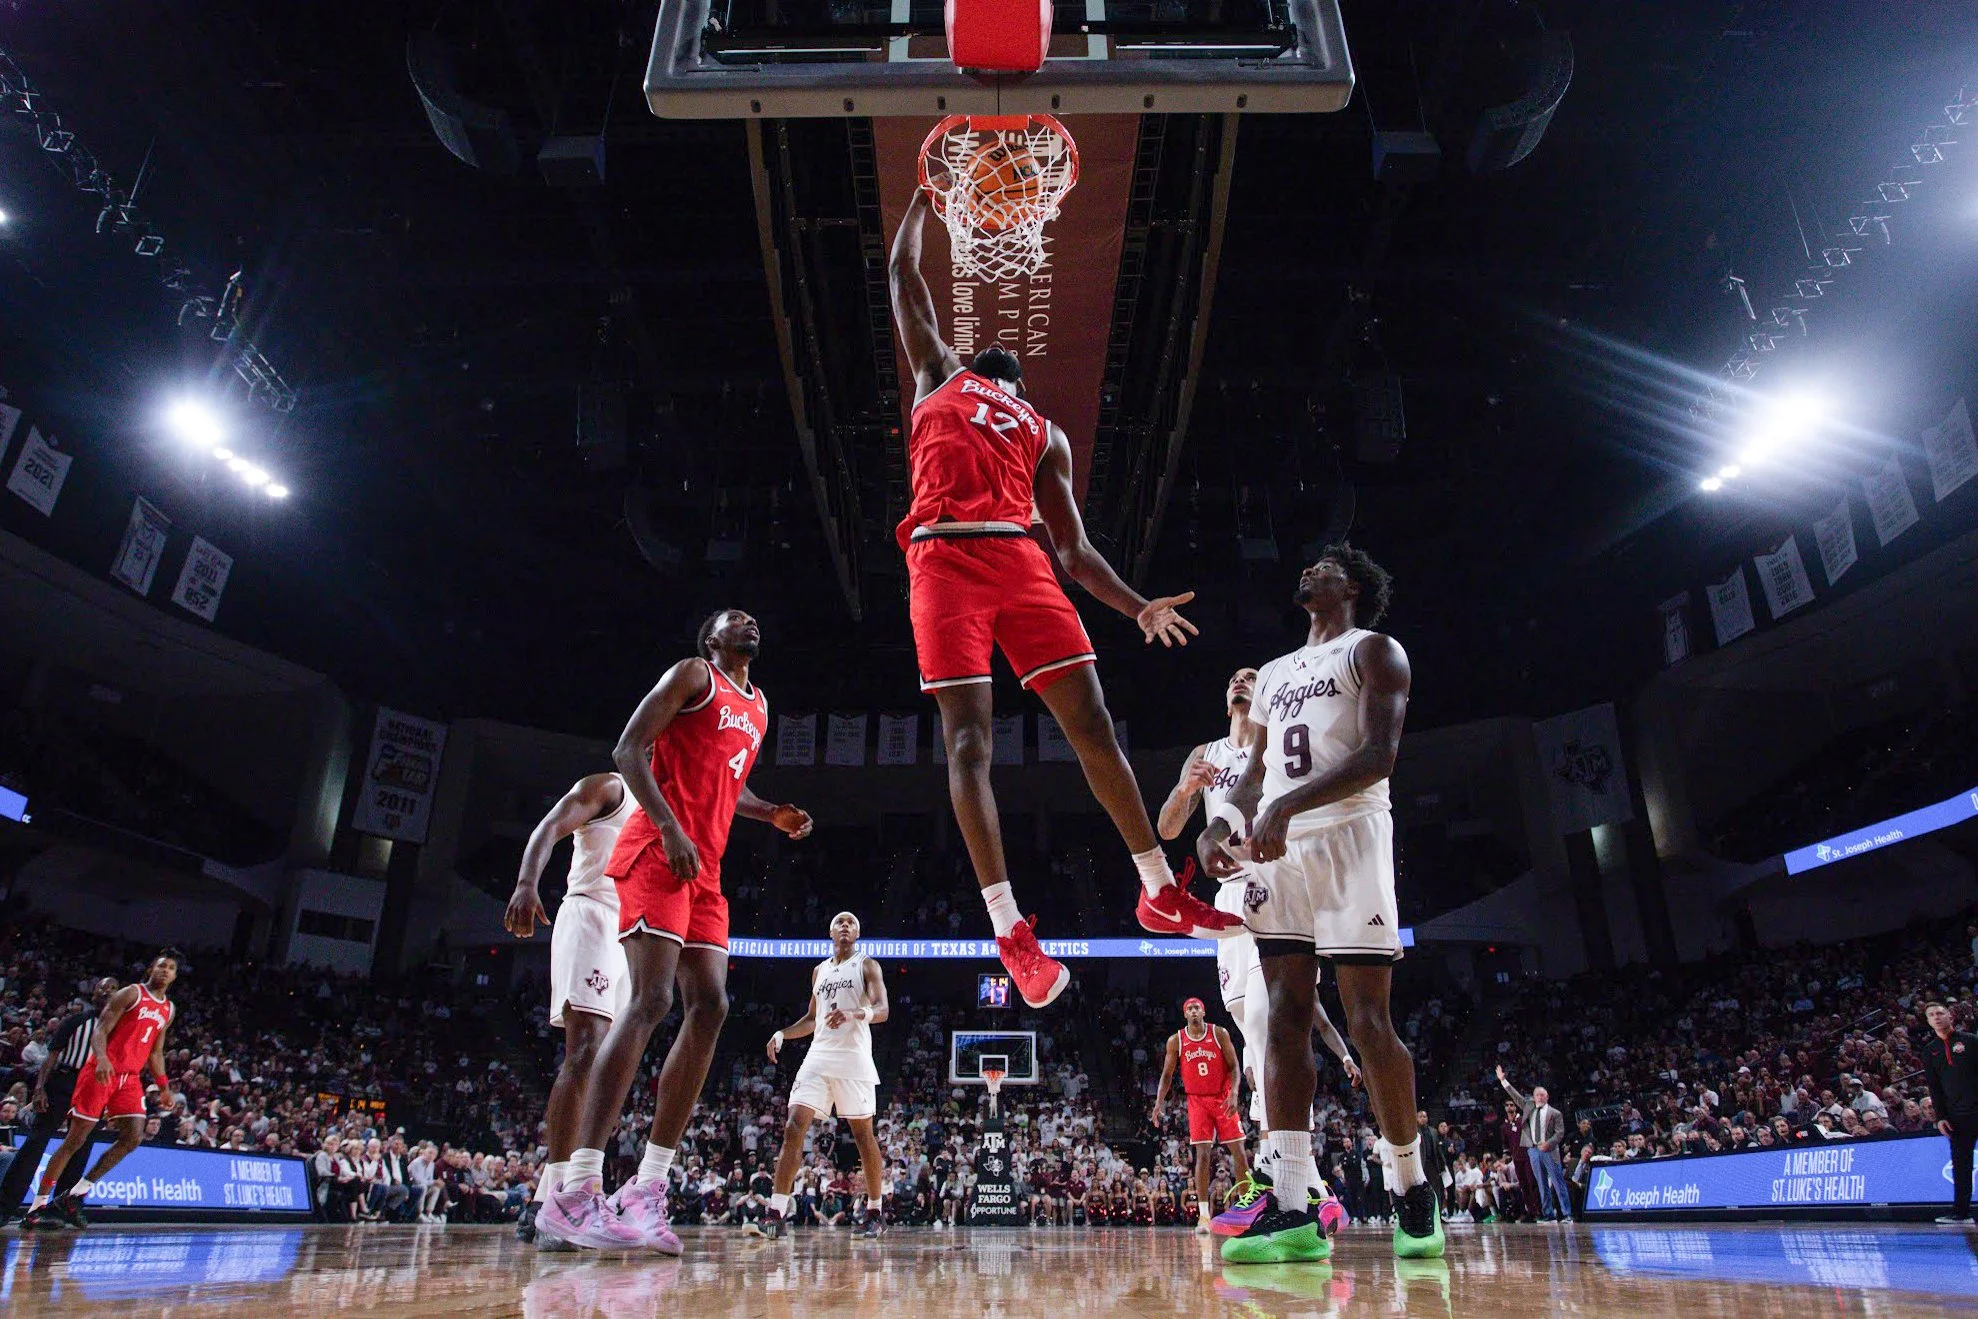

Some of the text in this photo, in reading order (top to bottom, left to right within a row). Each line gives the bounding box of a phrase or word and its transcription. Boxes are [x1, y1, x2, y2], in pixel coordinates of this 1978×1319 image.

[952, 281, 980, 314] love
[960, 378, 1040, 435] Buckeyes
[970, 402, 1019, 444] 12
[1268, 676, 1342, 722] Aggies
[728, 747, 748, 780] 4
[1283, 723, 1312, 779] 9
[1832, 829, 1904, 859] St. Joseph Health
[780, 942, 834, 956] HEALTHCA
[854, 942, 908, 956] PROVIDER
[913, 942, 926, 956] OF
[931, 942, 976, 956] TEXAS
[1039, 942, 1089, 956] LETICS
[1153, 947, 1215, 956] St. Joseph Health
[817, 978, 854, 1001] Aggies
[990, 987, 1006, 1004] 17
[141, 1026, 153, 1043] 1
[1197, 1062, 1209, 1077] 8
[230, 1159, 238, 1181] A
[237, 1160, 272, 1183] MEMBER
[1784, 1148, 1855, 1176] A MEMBER OF
[89, 1175, 203, 1206] Joseph Health
[977, 1184, 1011, 1194] WELLS
[977, 1194, 1012, 1204] FARGO
[1609, 1183, 1701, 1209] St. Joseph Health
[1771, 1174, 1866, 1203] ST. LUKE'S HEALTH
[970, 1202, 1017, 1219] OPPORTUNE
